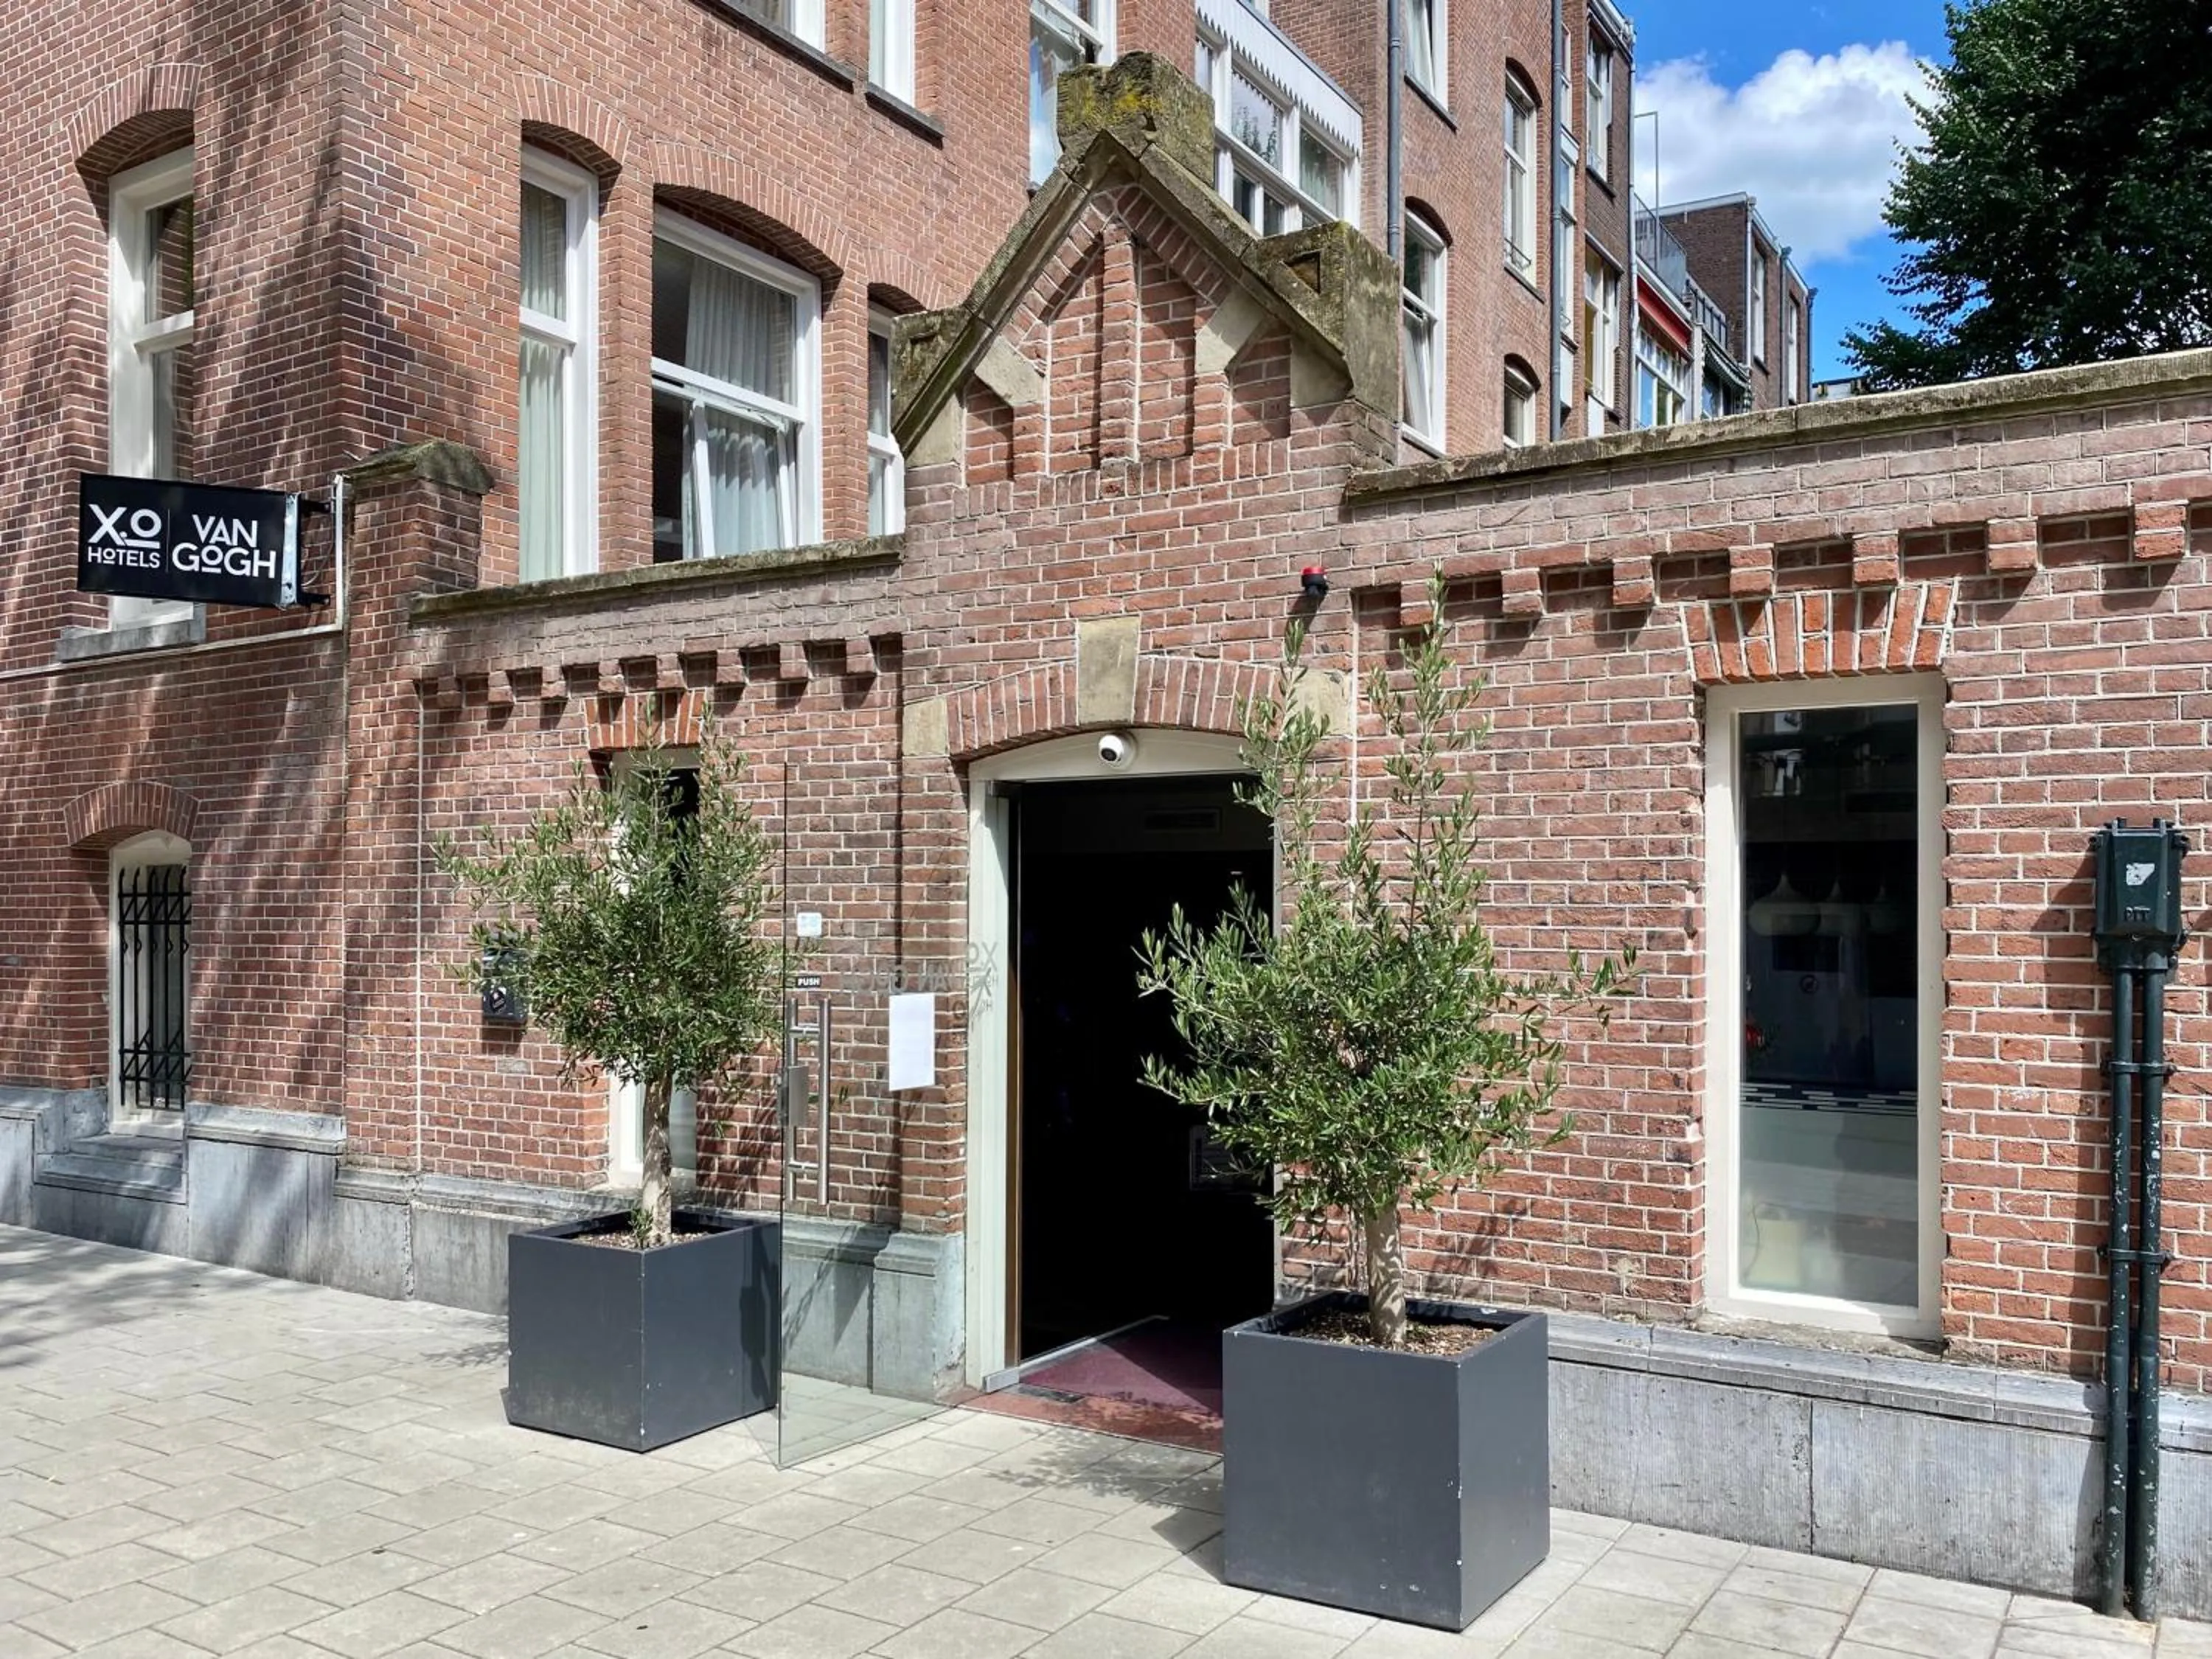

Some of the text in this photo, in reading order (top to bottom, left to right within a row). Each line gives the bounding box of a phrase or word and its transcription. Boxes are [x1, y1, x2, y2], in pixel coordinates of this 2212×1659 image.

[192, 515, 257, 548] VAN
[88, 546, 161, 568] HOTELS
[172, 542, 276, 579] GOGH
[798, 977, 821, 986] PUSH
